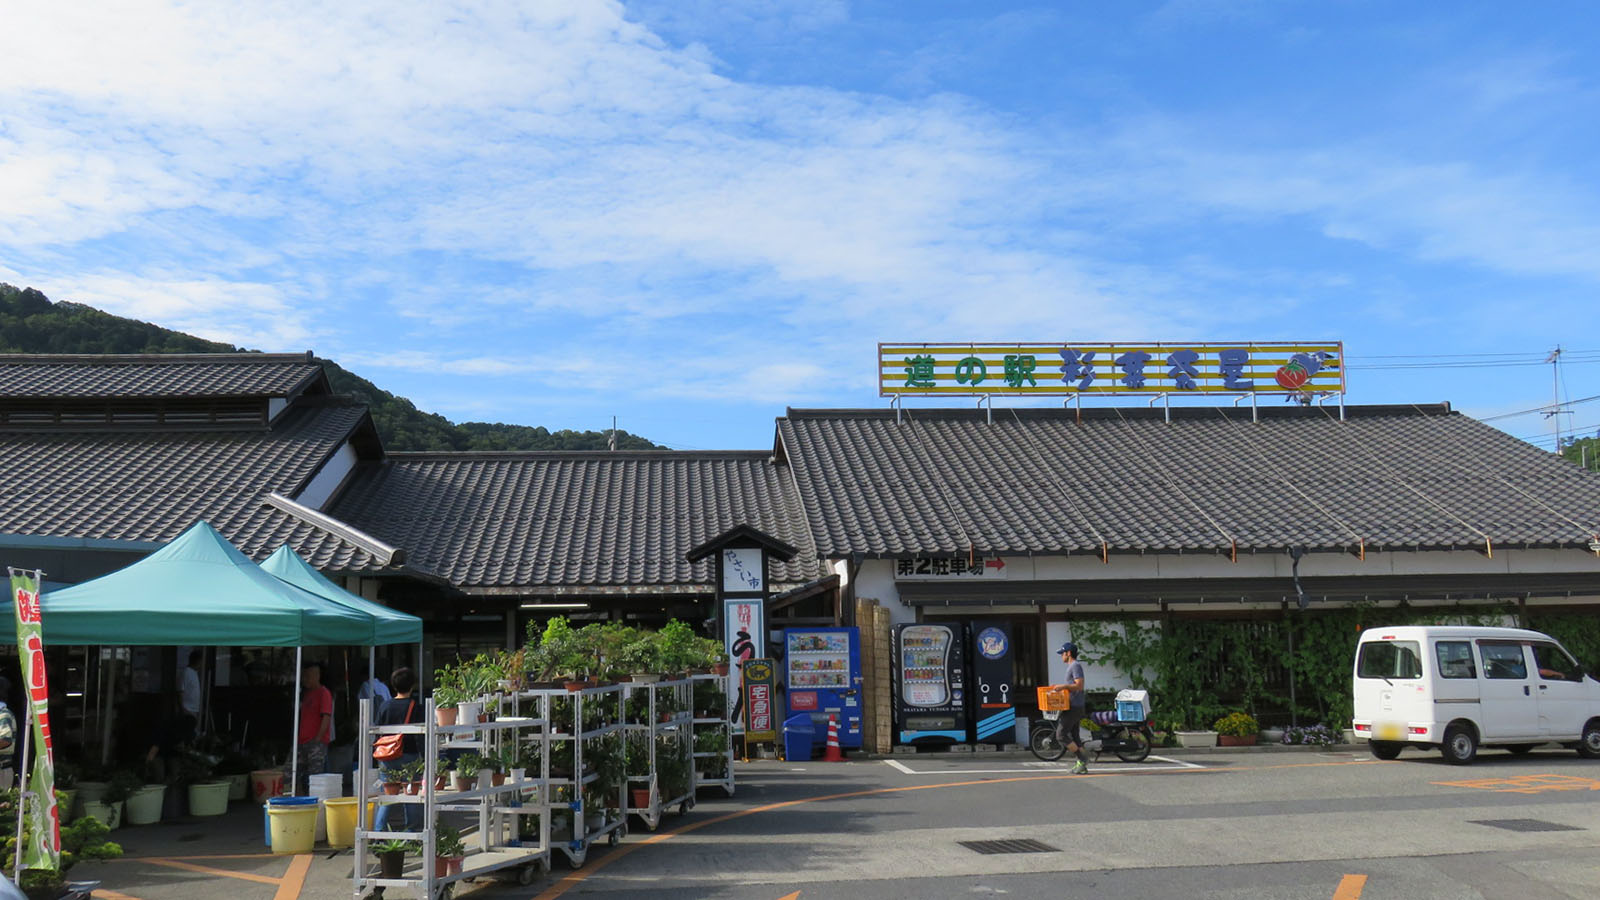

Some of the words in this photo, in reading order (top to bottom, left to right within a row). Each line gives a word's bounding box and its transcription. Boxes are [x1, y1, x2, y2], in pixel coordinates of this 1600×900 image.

[904, 354, 1037, 387] 道の駅
[725, 550, 760, 589] やさい市
[897, 557, 984, 576] 第2駐車場
[751, 685, 769, 729] 宅急便
